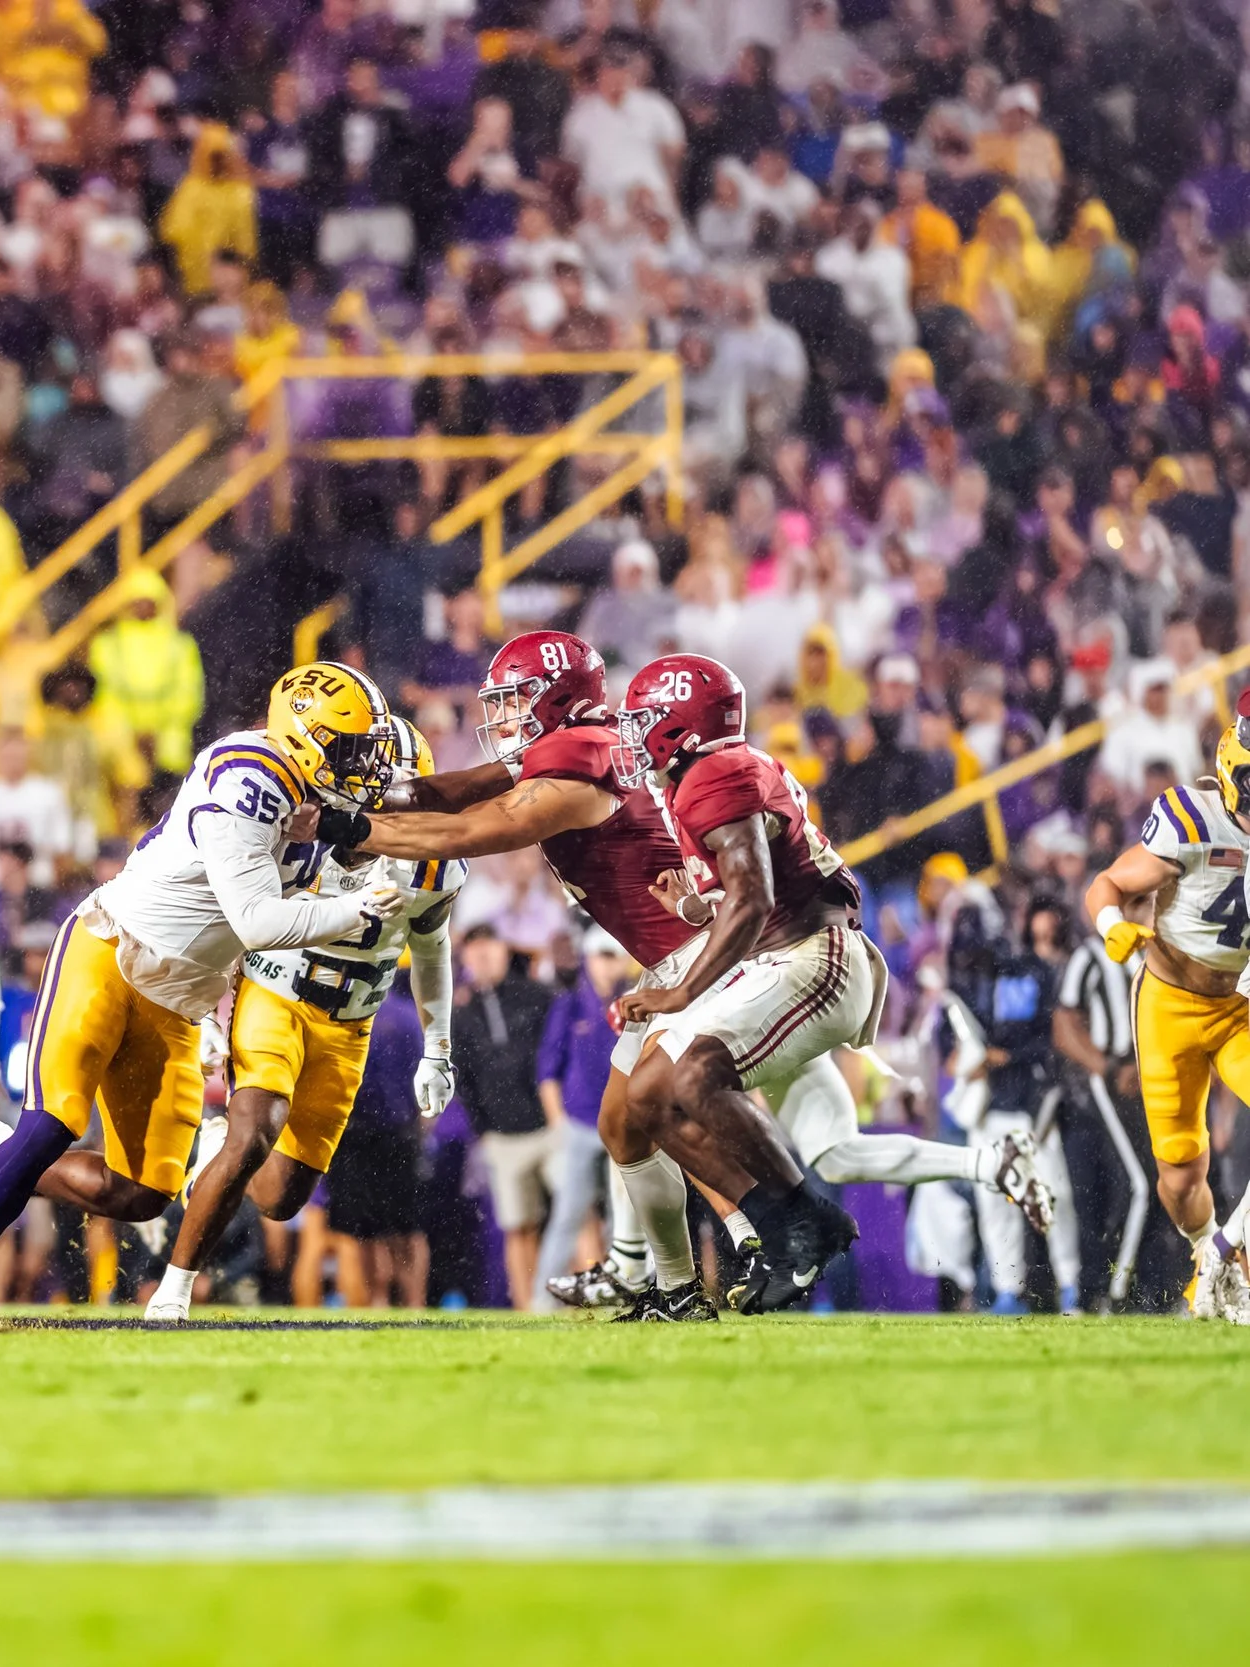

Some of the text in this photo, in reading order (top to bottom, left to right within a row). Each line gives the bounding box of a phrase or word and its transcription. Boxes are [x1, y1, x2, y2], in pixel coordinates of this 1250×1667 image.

[539, 642, 572, 671] 81
[281, 670, 346, 697] LSU
[659, 670, 693, 702] 26
[235, 776, 282, 825] 35
[1201, 876, 1250, 949] 4
[244, 951, 283, 980] UGLAS
